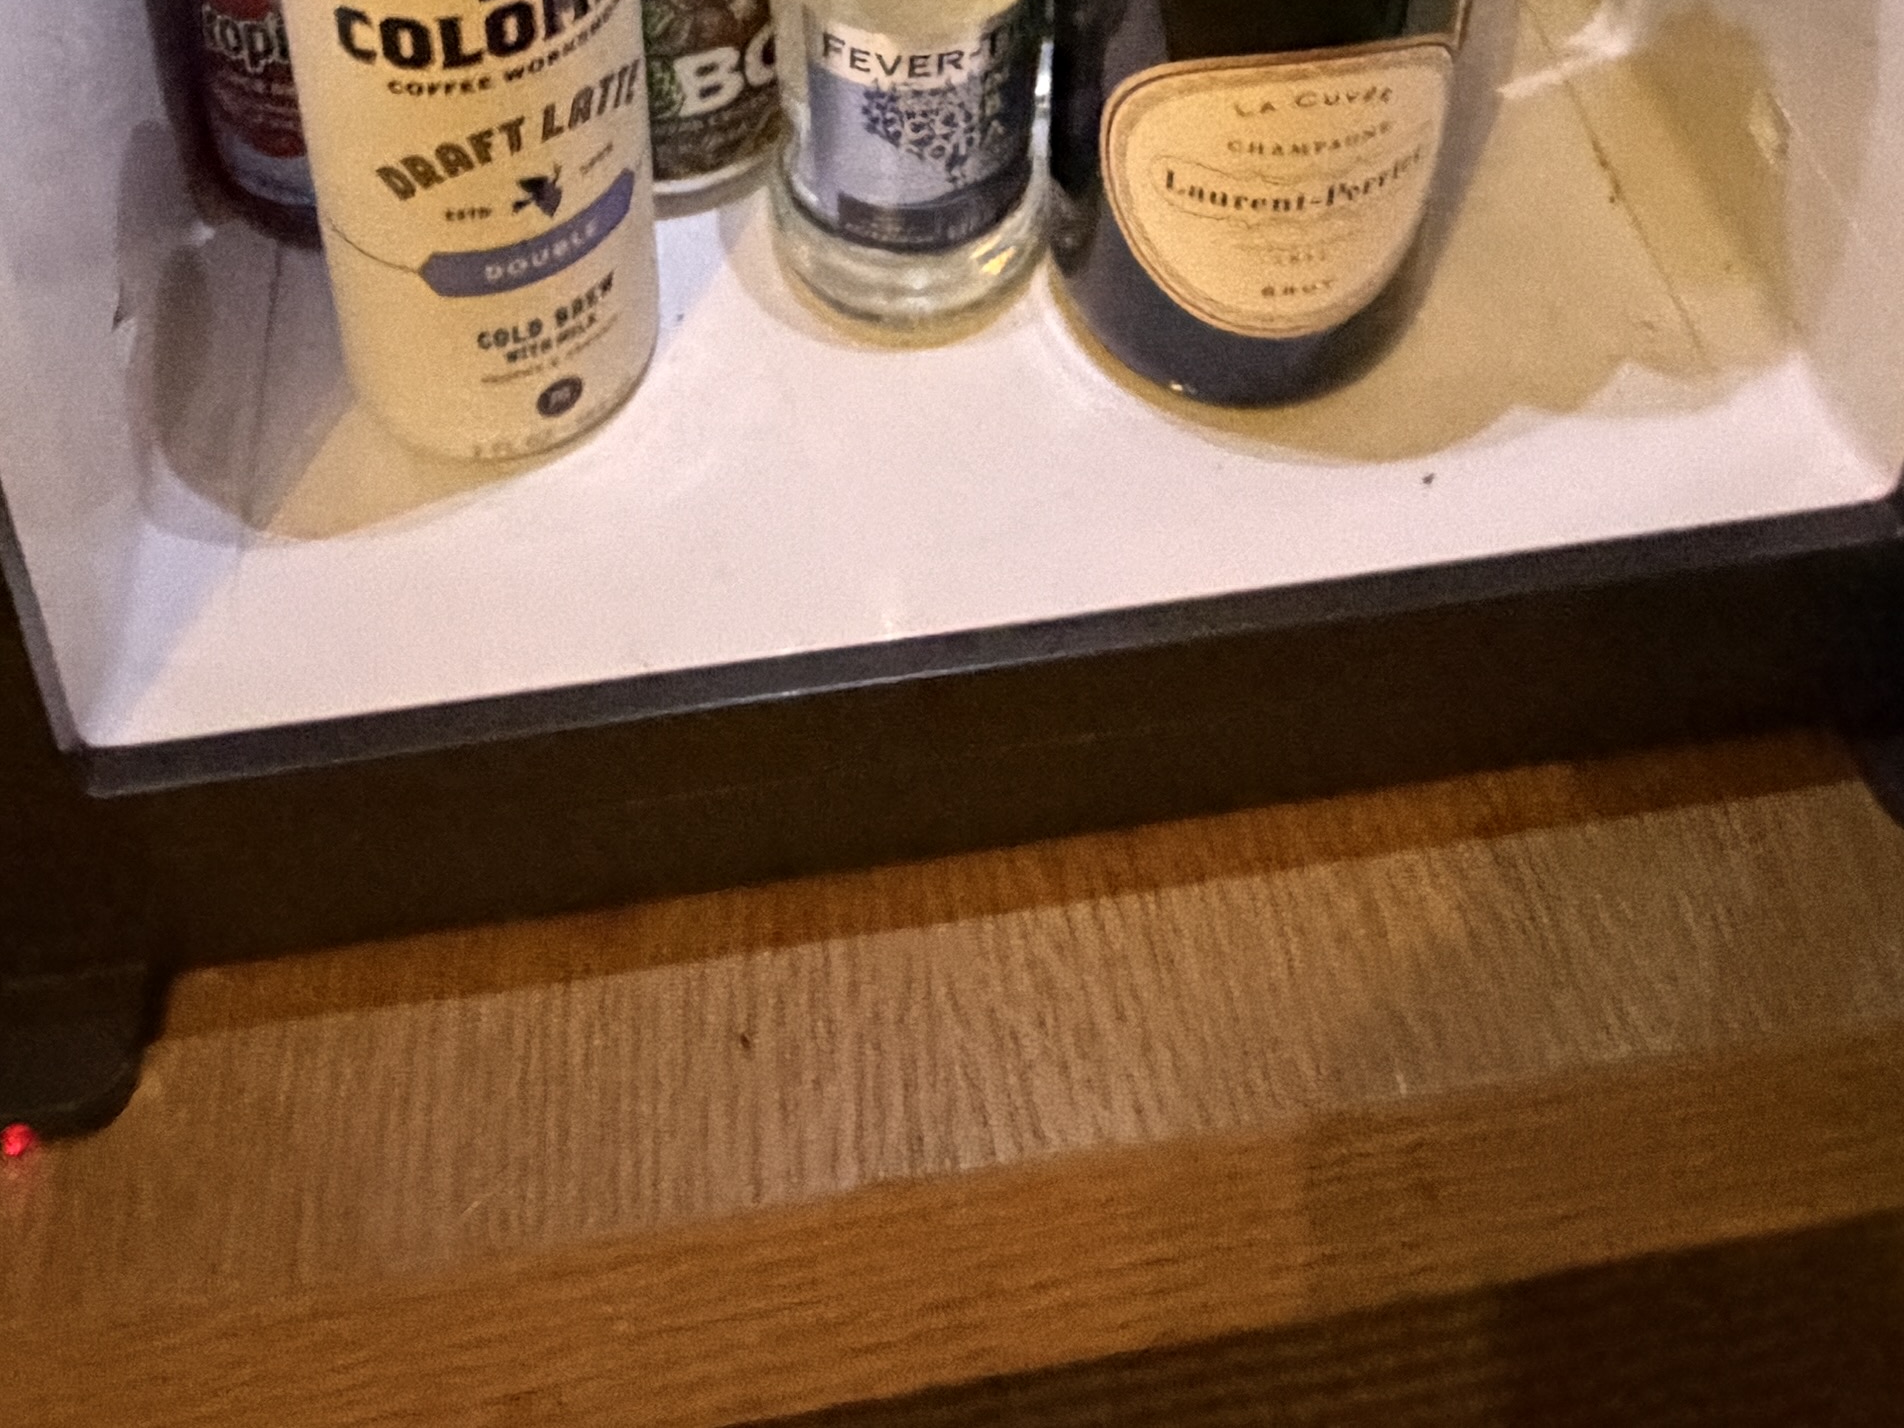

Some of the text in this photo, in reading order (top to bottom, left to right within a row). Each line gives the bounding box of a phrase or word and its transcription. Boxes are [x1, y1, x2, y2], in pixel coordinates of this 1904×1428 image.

[386, 75, 492, 97] COFFEE
[1233, 100, 1277, 118] LA
[374, 116, 526, 202] DRAFT
[483, 218, 599, 283] DOUBLE
[477, 269, 615, 351] COLD BREW
